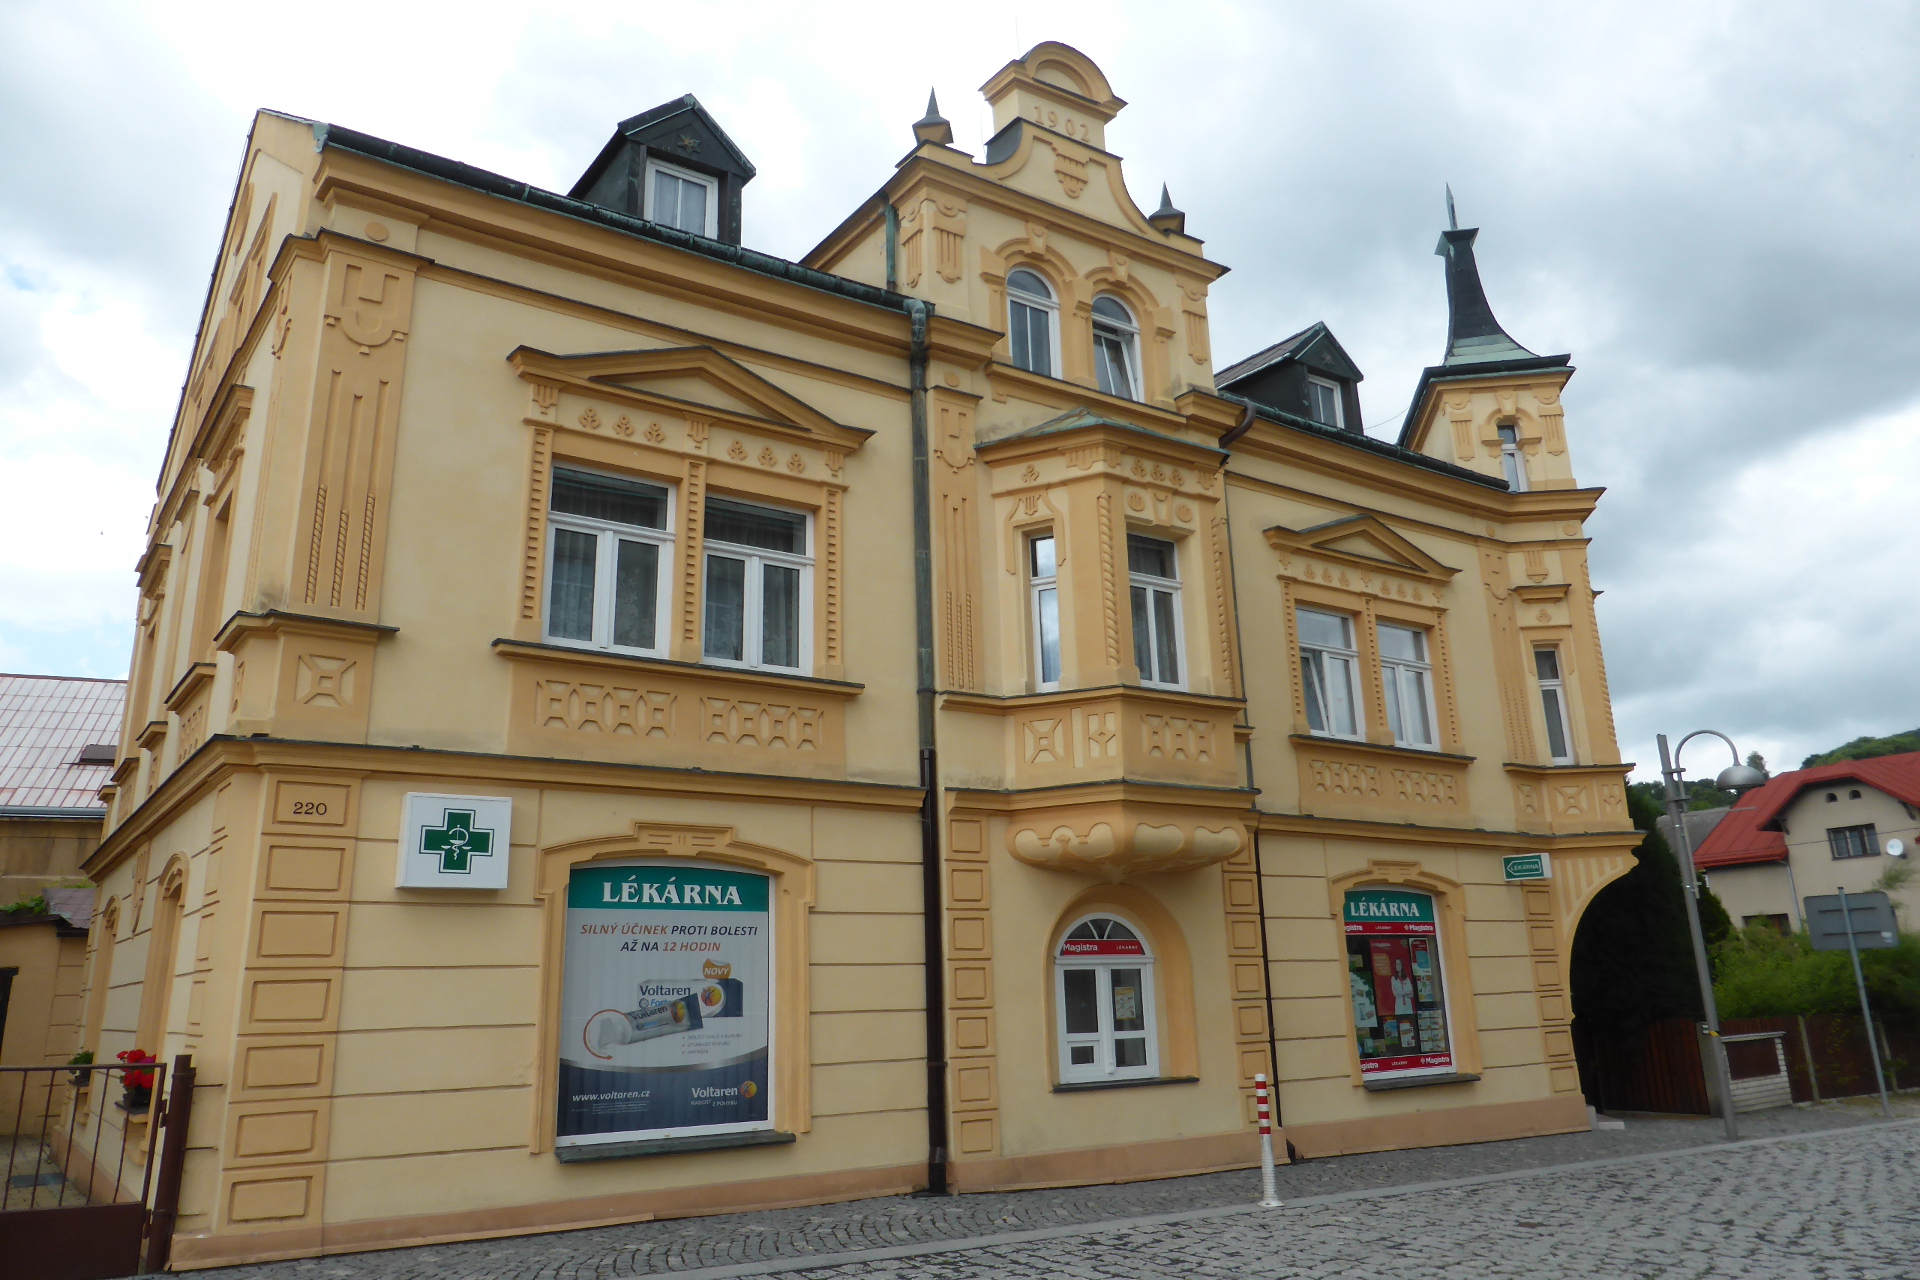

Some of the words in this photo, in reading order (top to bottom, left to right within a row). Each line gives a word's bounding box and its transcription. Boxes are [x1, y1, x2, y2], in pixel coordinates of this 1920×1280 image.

[1034, 106, 1090, 142] 1902
[293, 802, 327, 815] 220
[602, 874, 743, 905] LÉKÁRNA
[1350, 897, 1420, 916] LÉKÁRNA
[580, 922, 618, 935] SILNÝ
[621, 922, 669, 935] ÚČINEK
[671, 925, 708, 936] PROTI
[710, 926, 758, 936] BOLESTI
[1345, 924, 1363, 932] gistra
[620, 939, 638, 952] AŽ
[640, 942, 659, 952] NA
[662, 942, 677, 952] 12
[680, 942, 721, 952] HODIN
[1063, 943, 1098, 953] Magistra
[640, 985, 691, 996] Voltaren
[629, 1005, 668, 1020] Voltaren
[1361, 1062, 1379, 1070] gistra
[1425, 1056, 1450, 1065] Magistra
[572, 1090, 650, 1102] www.voltaren.cz
[691, 1086, 740, 1098] Voltaren
